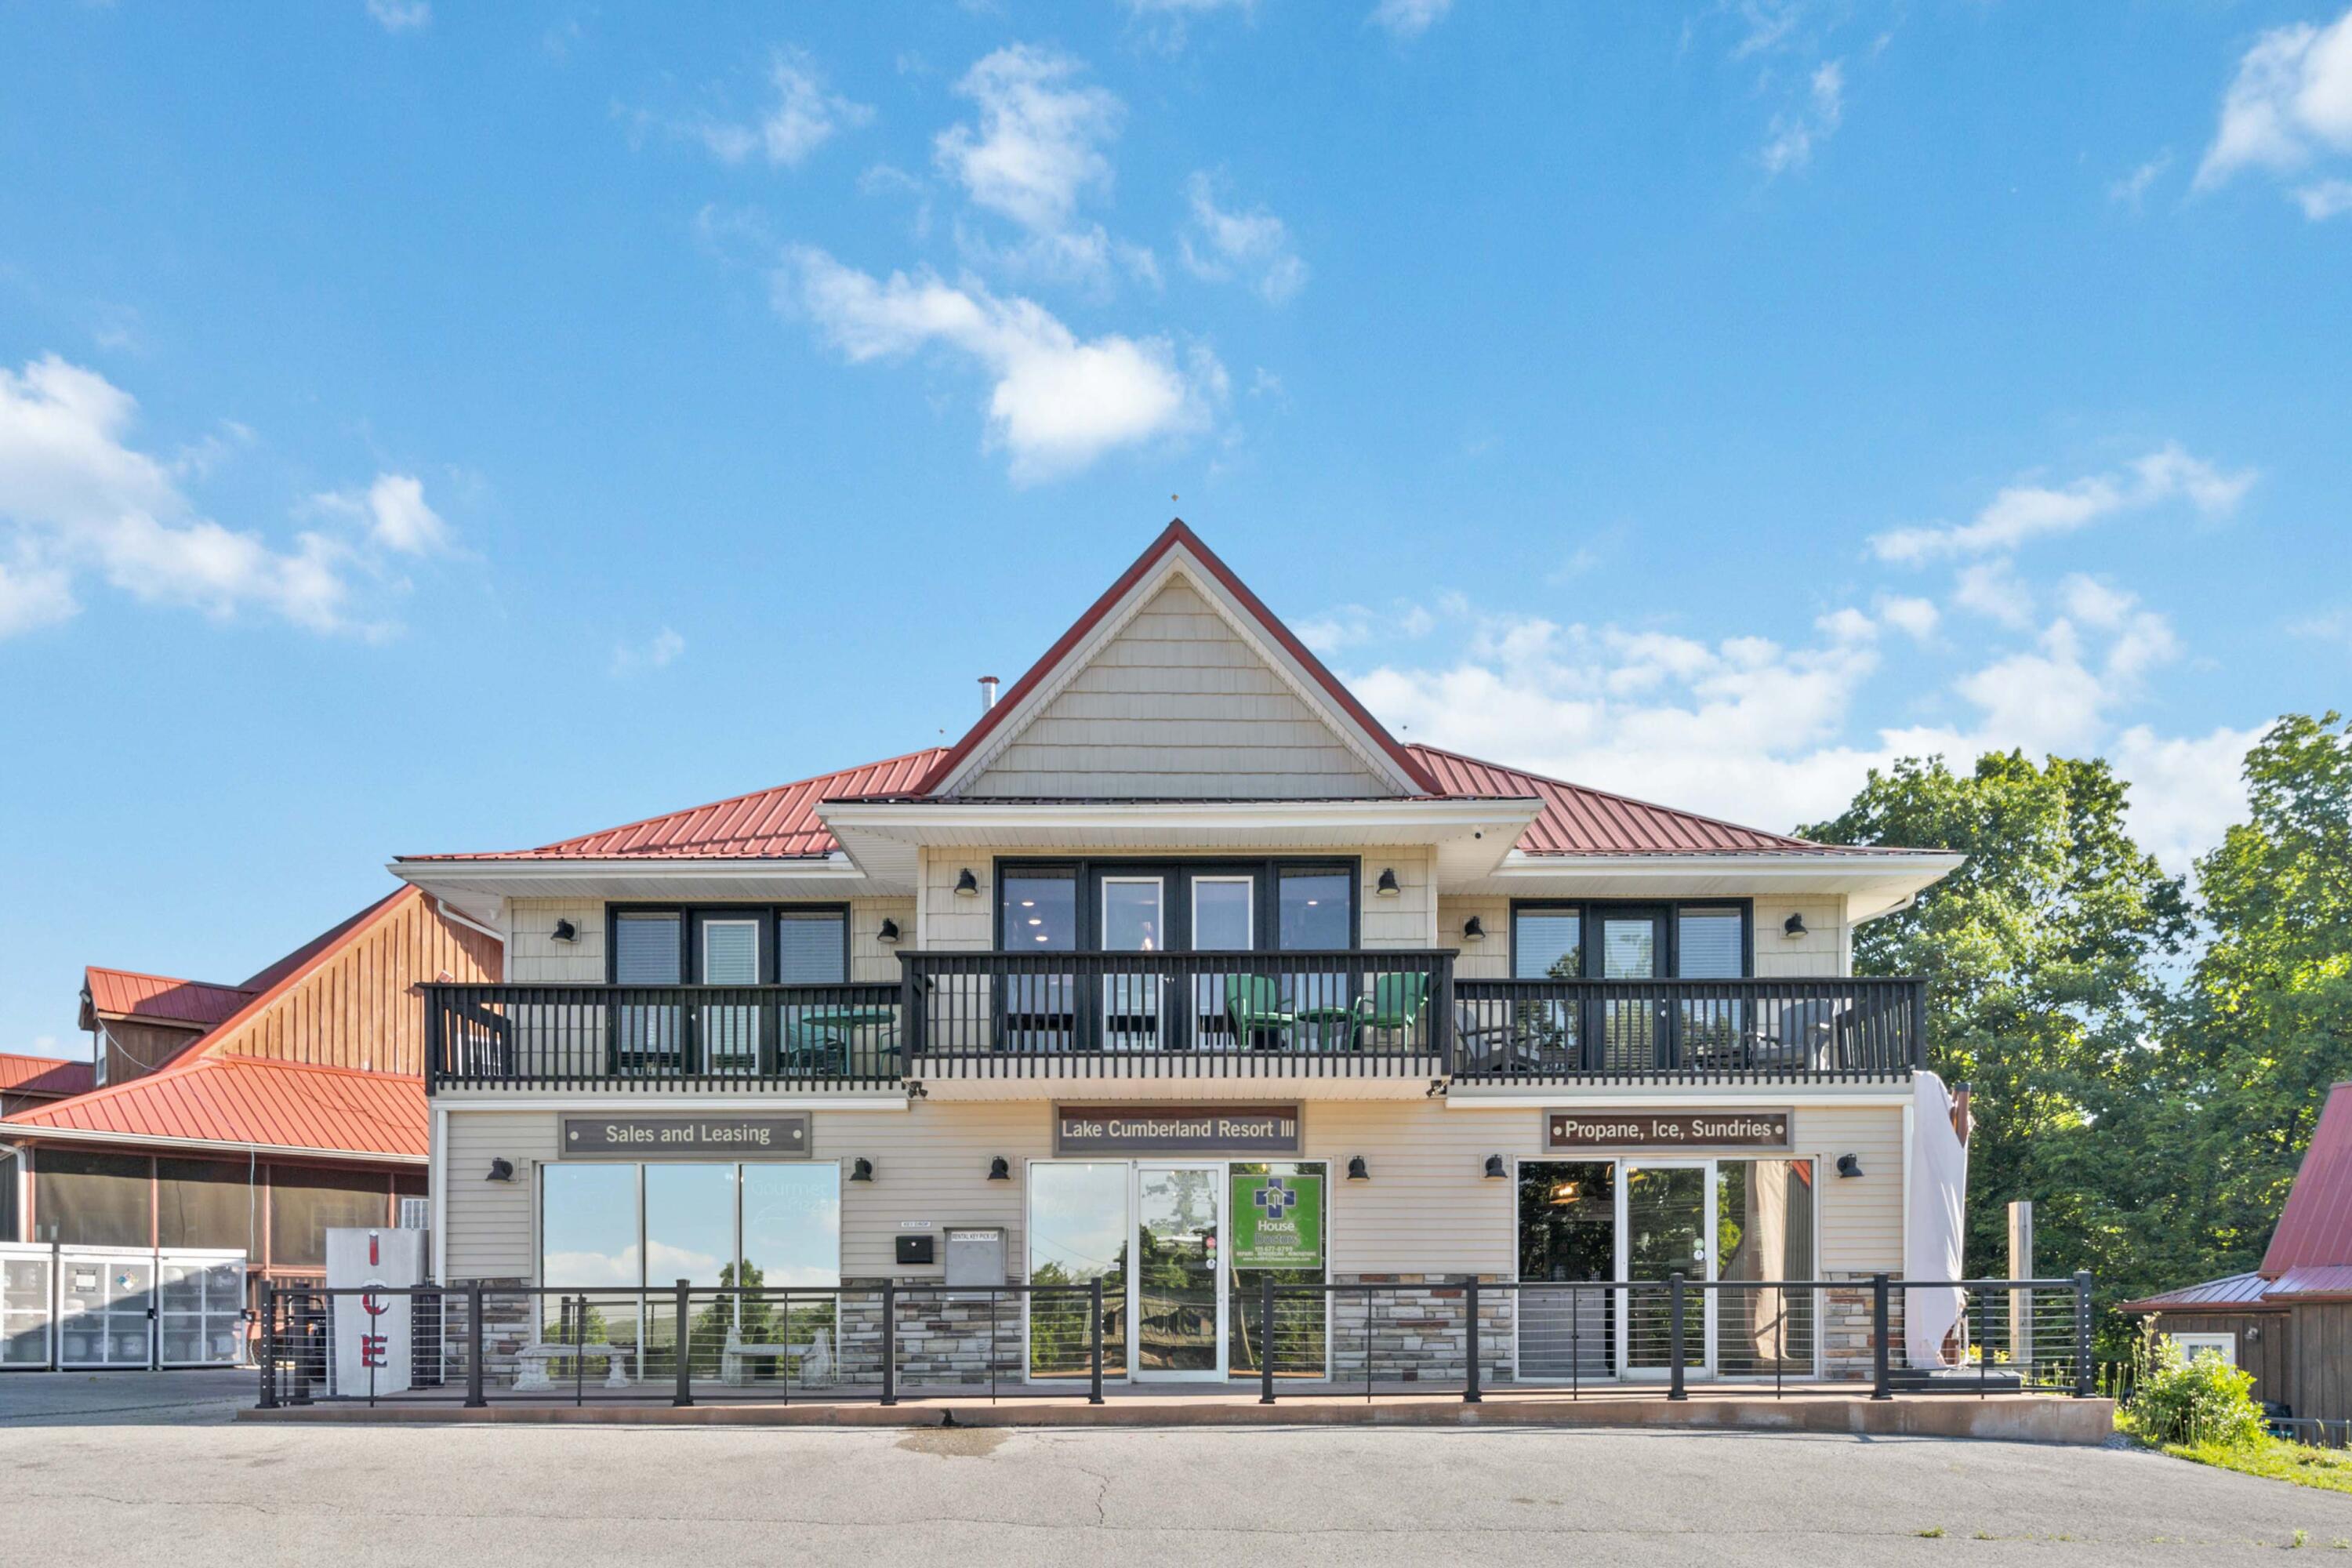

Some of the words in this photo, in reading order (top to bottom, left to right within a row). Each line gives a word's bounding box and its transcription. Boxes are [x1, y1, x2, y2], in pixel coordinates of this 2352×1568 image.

[606, 1125, 654, 1142] Sales
[661, 1125, 694, 1142] and
[702, 1124, 771, 1145] Leasing
[1062, 1120, 1102, 1137] Lake
[1109, 1120, 1211, 1137] Cumberland
[1219, 1120, 1273, 1137] Resort
[1281, 1120, 1294, 1137] III
[1566, 1120, 1644, 1142] Propane,
[1653, 1120, 1684, 1140] Ice,
[1692, 1120, 1771, 1137] Sundries
[1258, 1220, 1295, 1231] House
[1254, 1232, 1298, 1245] Doctors
[361, 1230, 390, 1367] ICE
